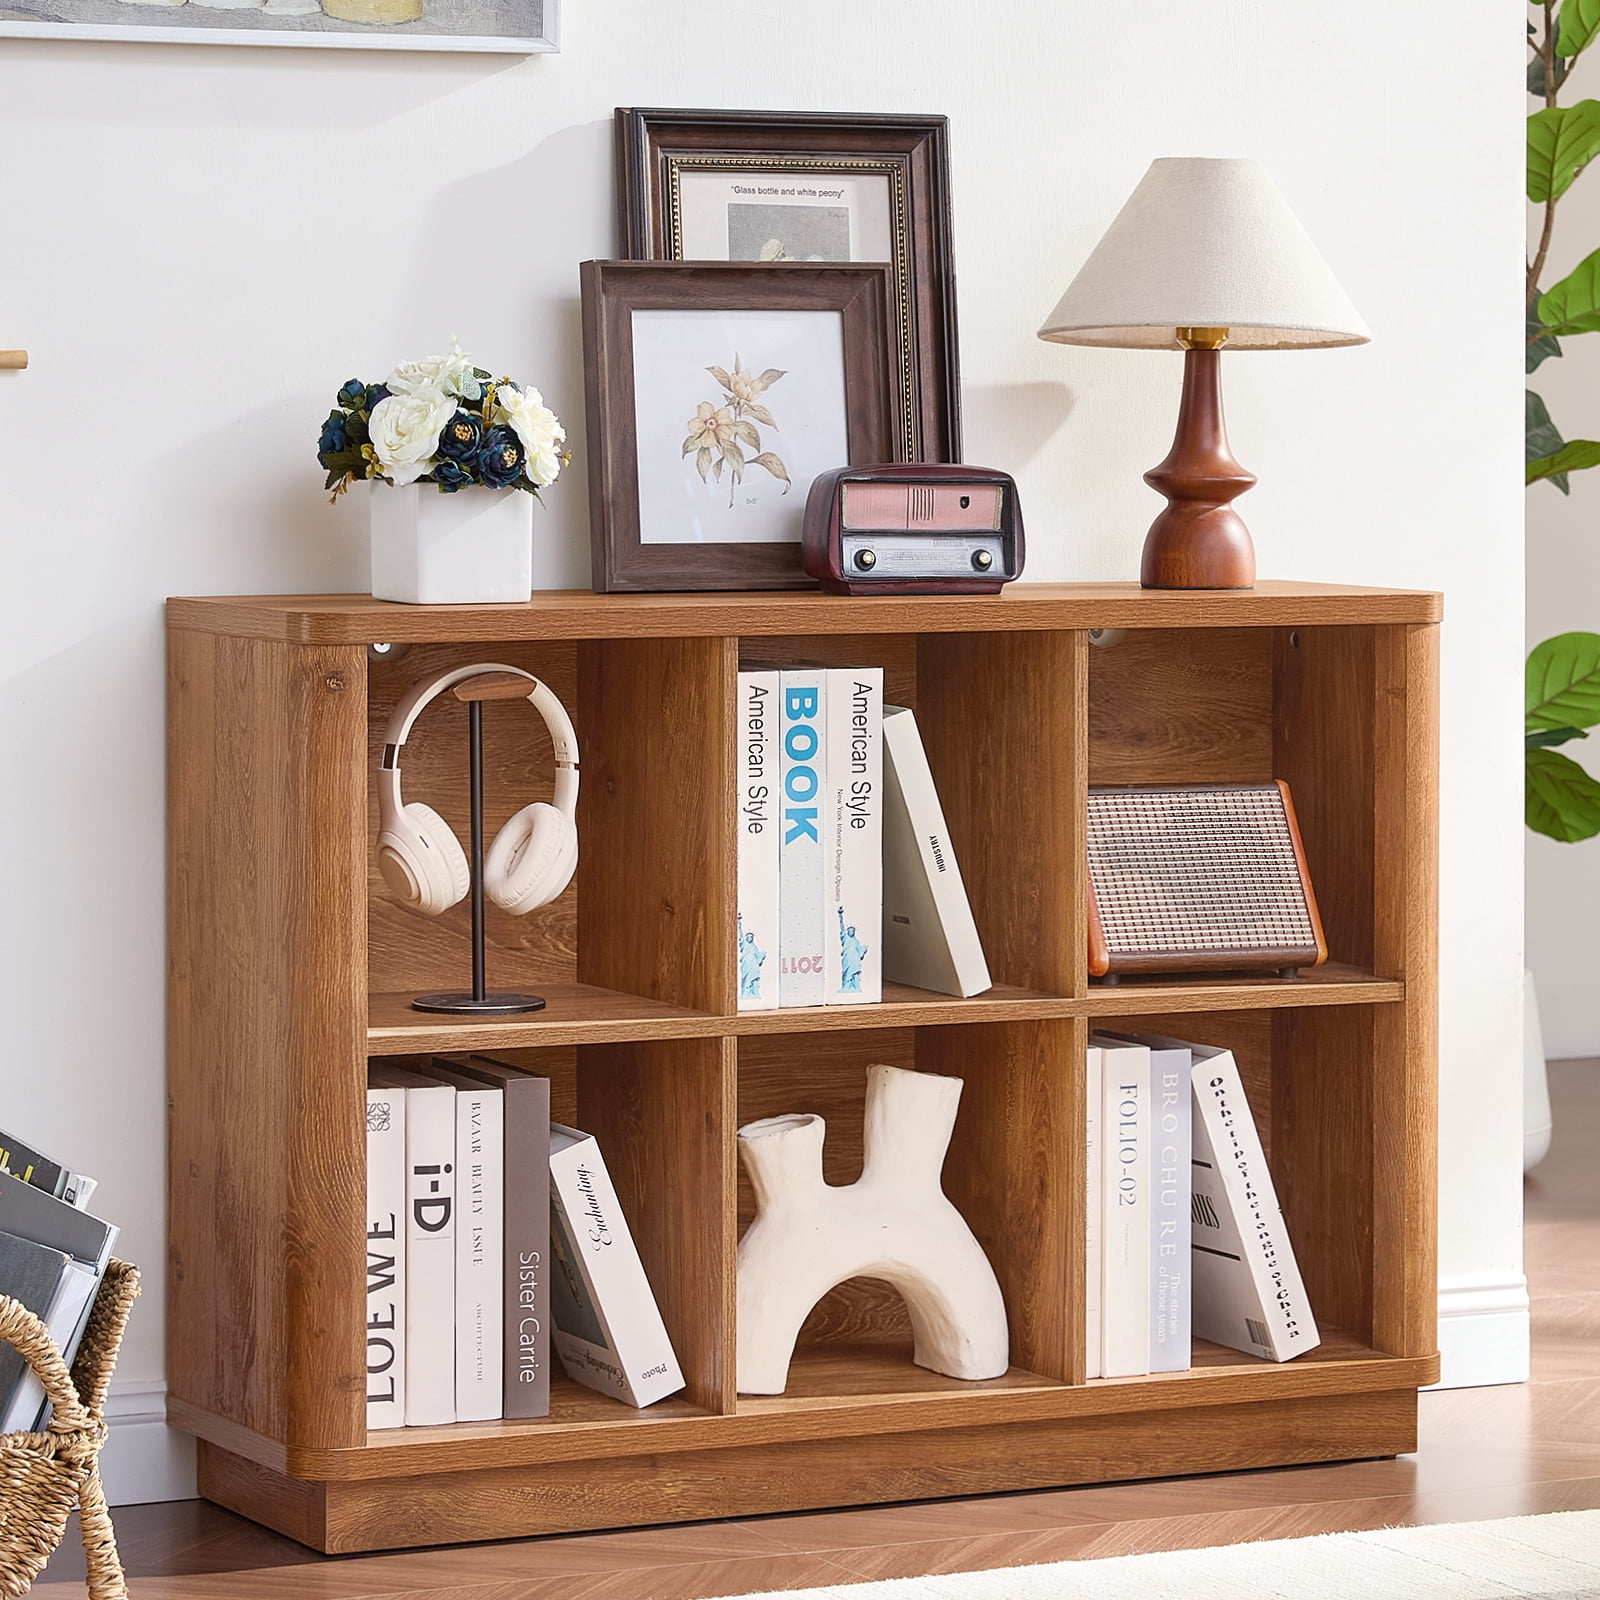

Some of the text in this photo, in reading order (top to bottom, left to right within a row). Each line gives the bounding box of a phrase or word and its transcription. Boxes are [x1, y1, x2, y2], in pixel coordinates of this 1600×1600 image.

[758, 187, 779, 195] bottle
[780, 188, 795, 196] and
[797, 189, 817, 197] white
[743, 684, 769, 834] American Style
[785, 687, 818, 845] BOOK
[846, 681, 873, 829] American Style
[836, 788, 844, 804] New
[836, 805, 844, 822] York
[834, 849, 843, 874] Design
[929, 835, 946, 873] INDUSTRY
[782, 955, 823, 974] 2011
[471, 1102, 482, 1154] BAZAAR
[1118, 1083, 1138, 1206] FOLIO-02
[413, 1163, 453, 1233] i-D
[367, 1213, 396, 1403] LOEWE
[519, 1251, 540, 1383] Sister Carrie
[1156, 1266, 1169, 1345] of those years
[1169, 1272, 1181, 1336] The stories
[641, 1363, 668, 1380] Photo
